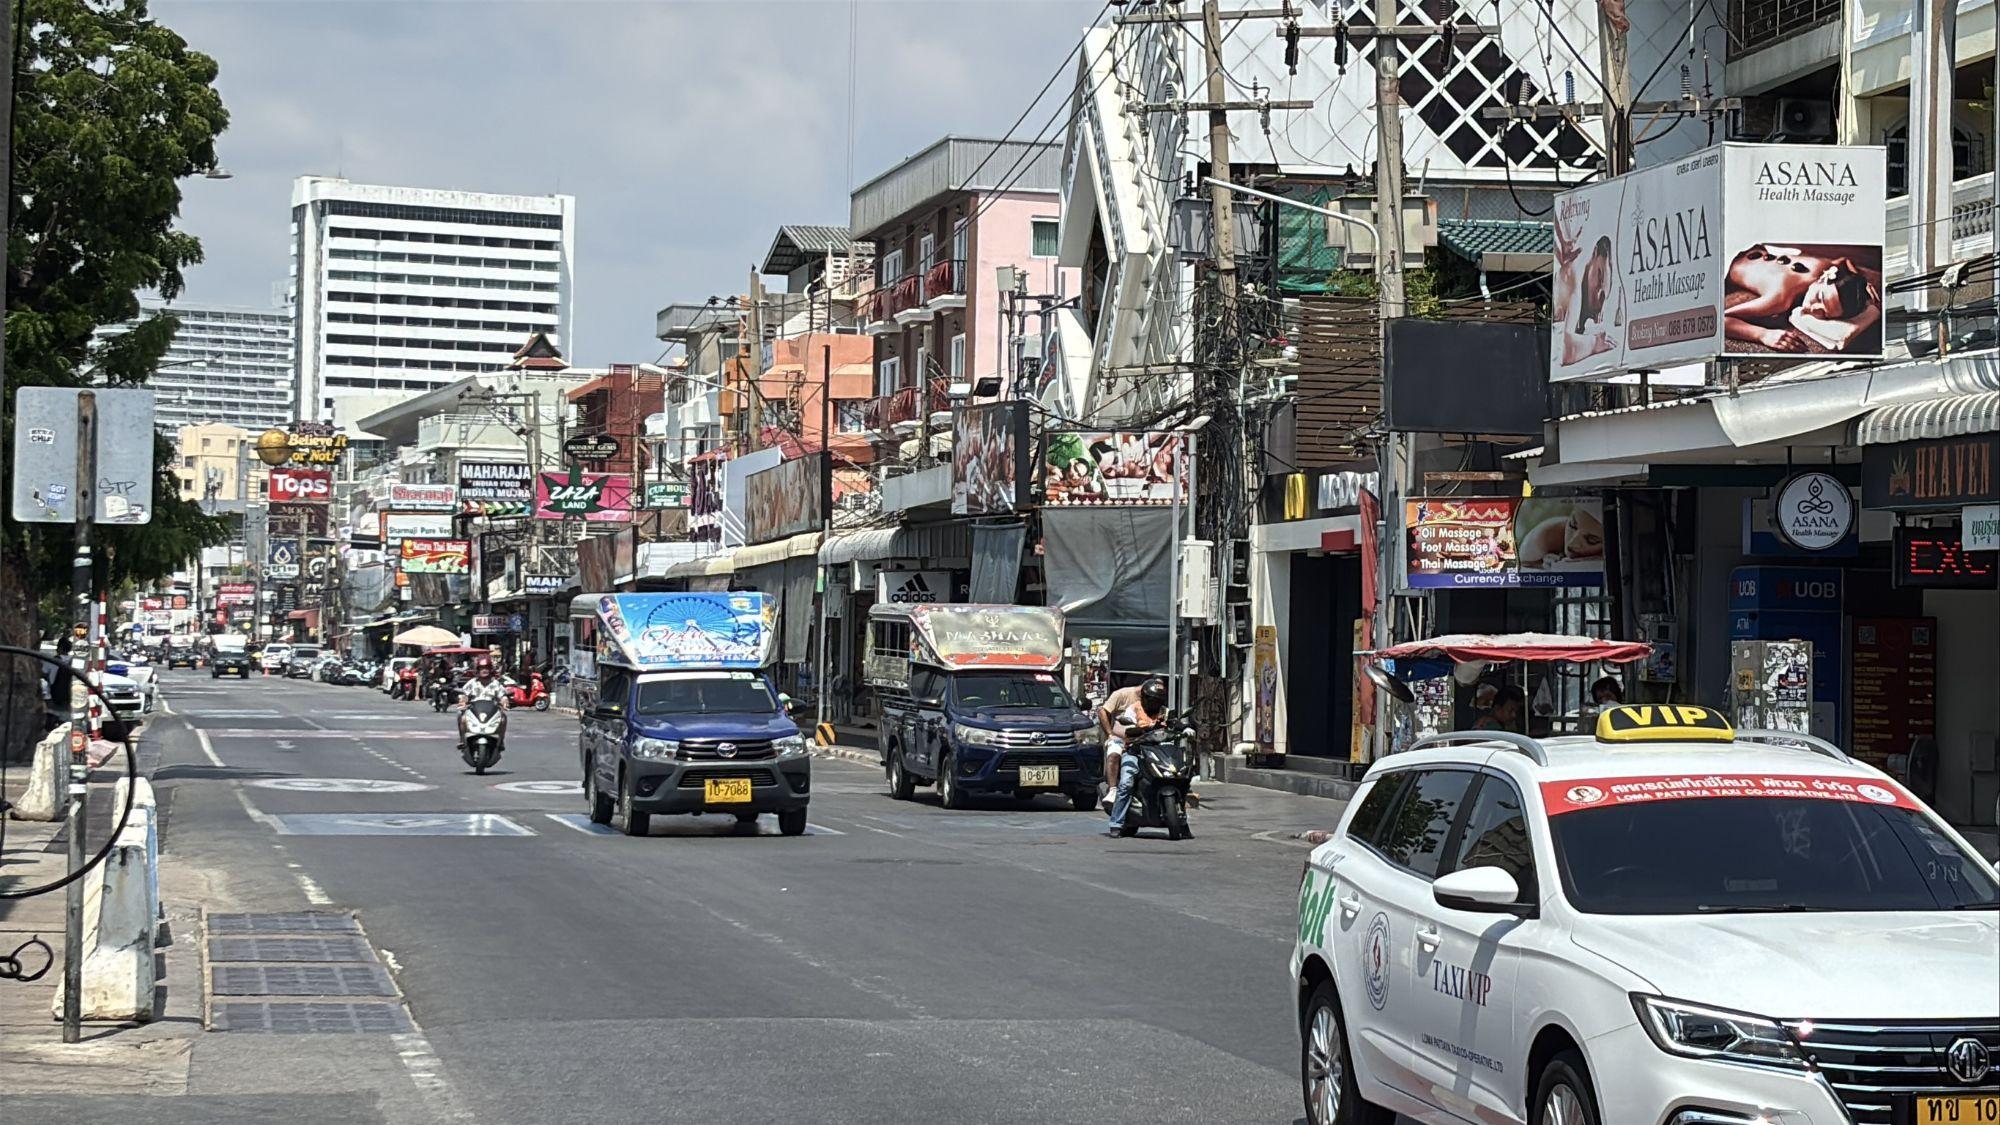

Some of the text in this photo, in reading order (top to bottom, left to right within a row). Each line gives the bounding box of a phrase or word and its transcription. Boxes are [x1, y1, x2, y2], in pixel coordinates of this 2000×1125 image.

[1754, 161, 1858, 187] ASANA
[1759, 187, 1855, 206] Health Massage
[1629, 204, 1712, 275] ASANA
[1634, 271, 1705, 303] Health Massage
[288, 433, 348, 447] Believe It
[292, 452, 306, 461] or
[462, 464, 531, 480] MAHARAJA
[1915, 443, 1991, 498] HEAVEN
[99, 478, 137, 496] STP
[272, 474, 328, 497] Tops
[461, 488, 495, 498] INDIAN
[649, 485, 666, 495] CUP
[562, 501, 587, 509] LAND
[1792, 516, 1839, 528] ASANA
[1421, 527, 1482, 540] Oil Massage
[1792, 529, 1839, 538] Health Massage
[1421, 542, 1489, 554] Foot Massage
[1420, 559, 1440, 569] Thai
[1443, 559, 1486, 571] Massage
[1454, 573, 1564, 586] Currency Exchange
[1738, 580, 1756, 597] UOB
[1794, 581, 1836, 598] UOB
[891, 591, 936, 603] adidas
[1620, 706, 1708, 726] VIP
[1616, 792, 1653, 803] LOMA
[1655, 788, 1712, 798] PATTAYA
[1712, 788, 1741, 797] TAXI
[1433, 960, 1492, 1007] TAXI VIP
[1928, 1098, 1960, 1122] ทข
